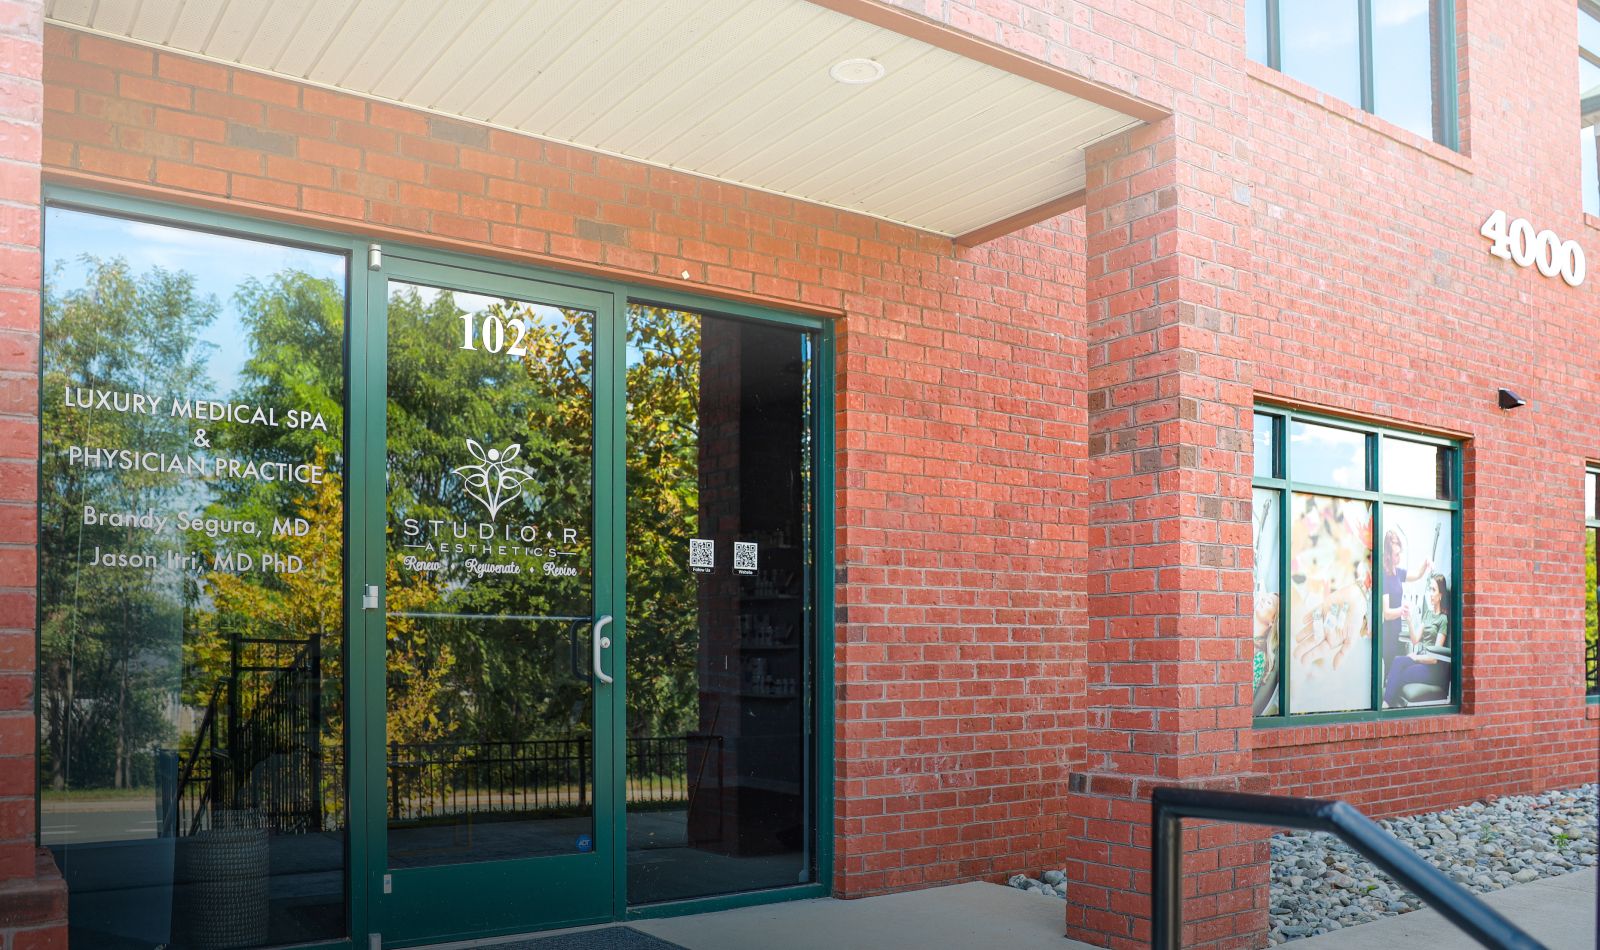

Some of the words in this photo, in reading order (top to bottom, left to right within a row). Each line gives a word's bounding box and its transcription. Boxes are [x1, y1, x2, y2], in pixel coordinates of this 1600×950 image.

[1480, 209, 1586, 287] 4000
[459, 312, 528, 357] 102
[65, 386, 162, 416] LUXURY
[171, 399, 279, 427] MEDICAL
[287, 410, 328, 431] SPA
[193, 428, 211, 448] &
[69, 445, 205, 475] PHYSICIAN
[215, 457, 323, 485] PRACTICE
[83, 505, 168, 535] Brandy
[177, 512, 262, 538] Segura,
[271, 517, 310, 537] MD
[89, 546, 157, 568] Jason
[167, 550, 203, 574] Itri,
[213, 552, 253, 572] MD
[262, 554, 304, 574] PhD
[425, 542, 557, 558] AESTHETICS
[403, 555, 441, 571] Renew
[465, 558, 521, 579] Rejuvenate
[543, 561, 578, 577] Revive
